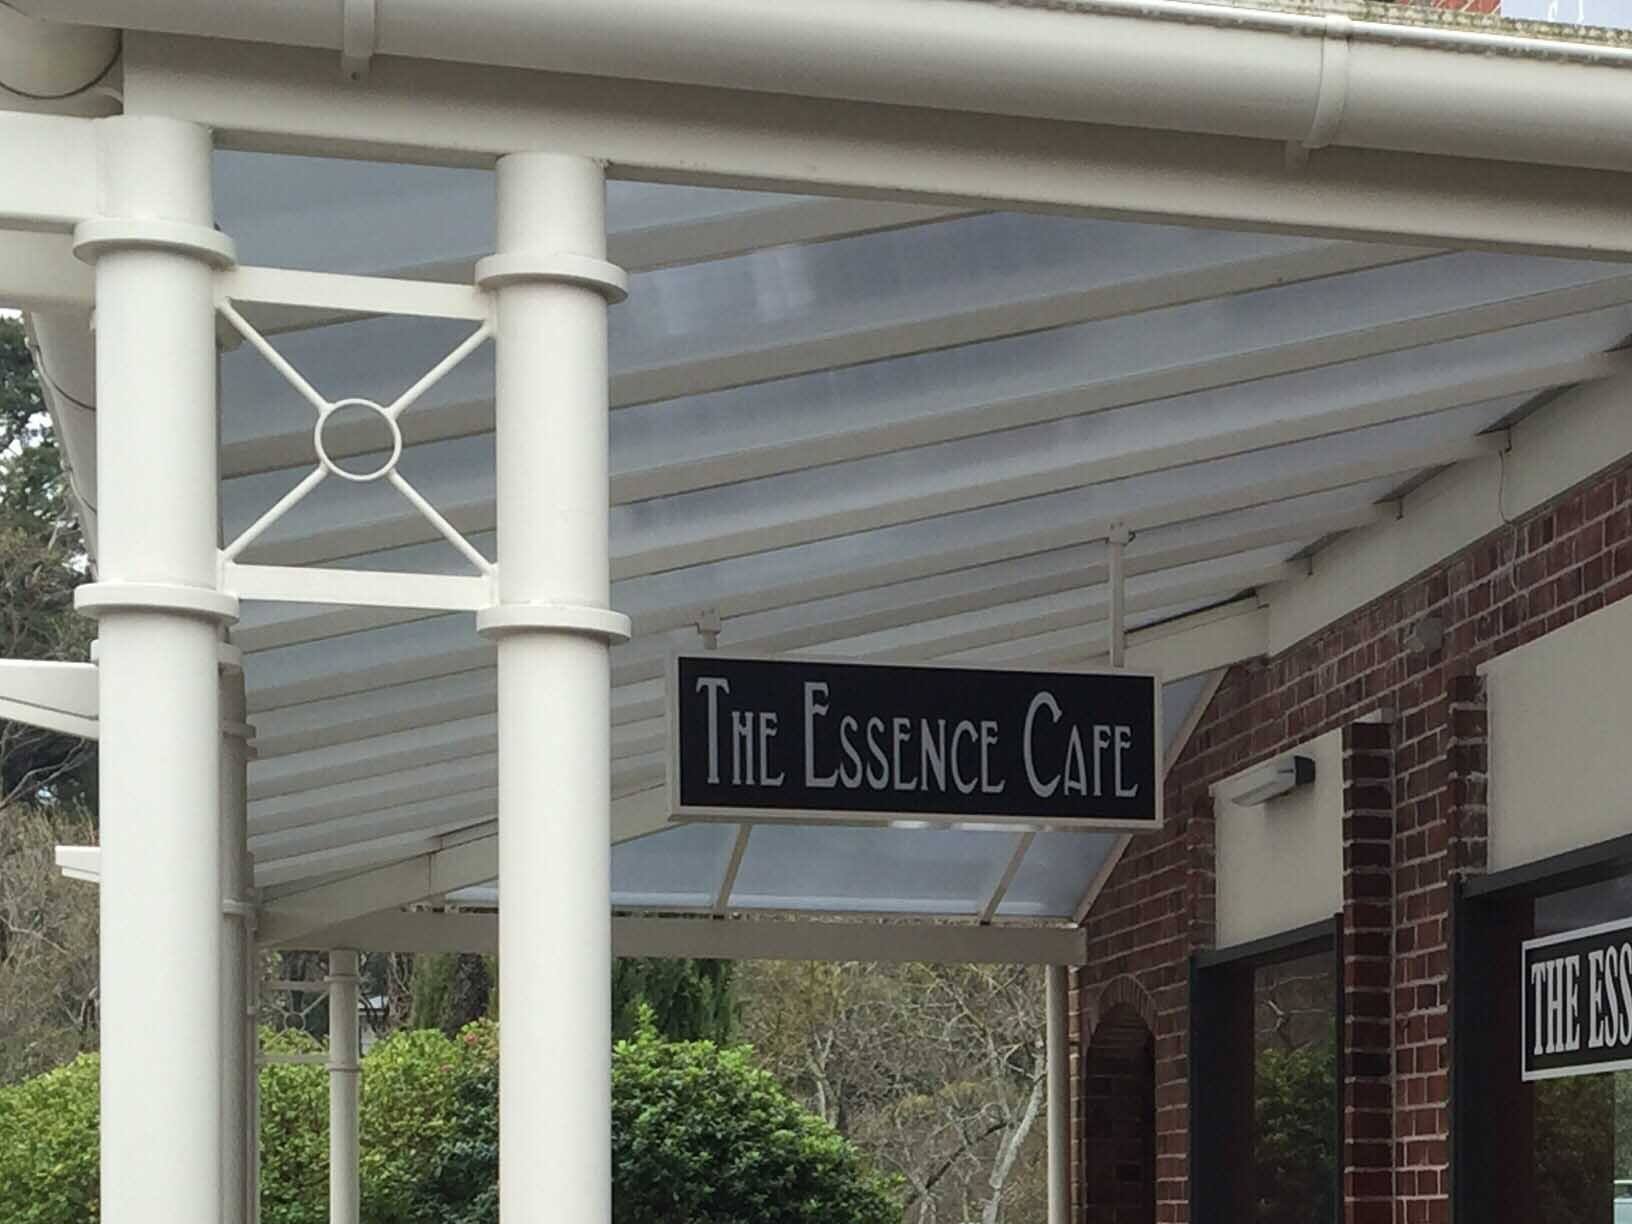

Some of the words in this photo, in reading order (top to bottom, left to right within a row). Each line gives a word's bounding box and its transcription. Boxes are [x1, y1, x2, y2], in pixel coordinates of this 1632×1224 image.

[697, 677, 785, 786] THE
[804, 681, 1006, 794] ESSENCE
[1023, 691, 1139, 799] CAFE
[1531, 954, 1580, 1055] THE
